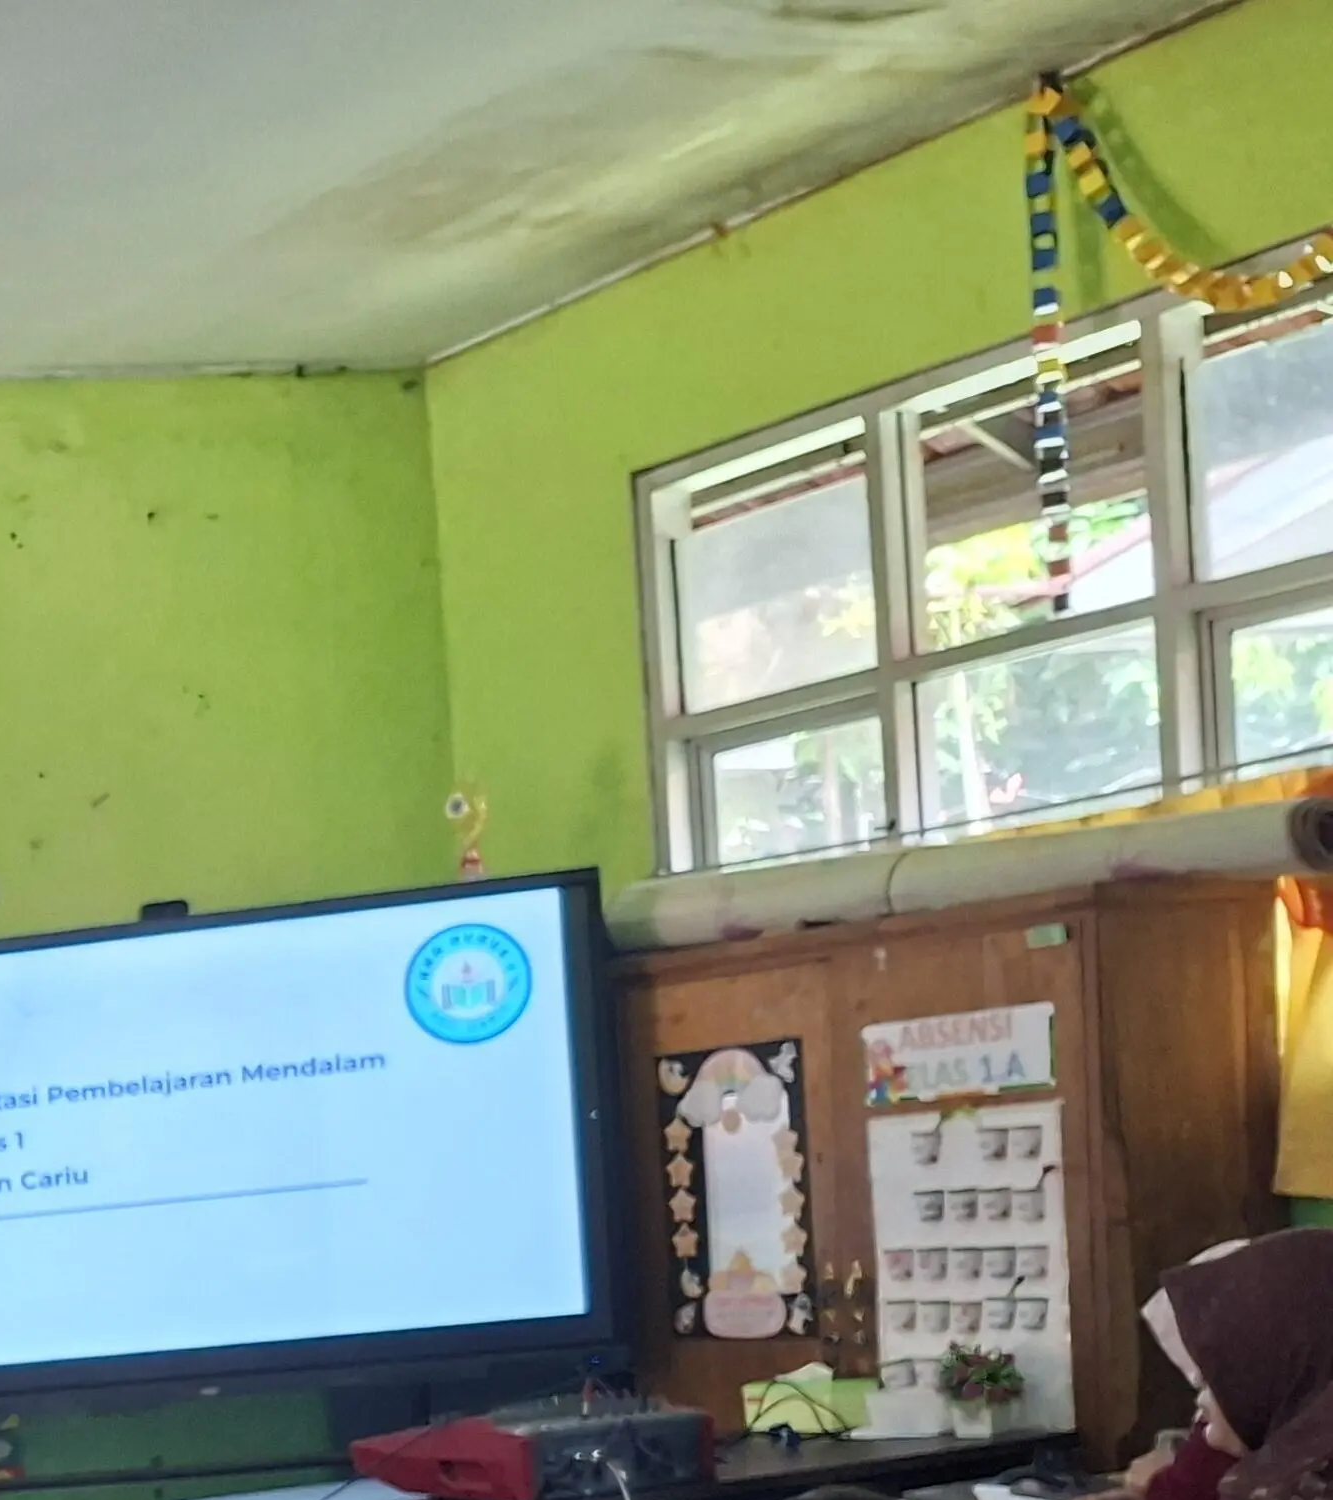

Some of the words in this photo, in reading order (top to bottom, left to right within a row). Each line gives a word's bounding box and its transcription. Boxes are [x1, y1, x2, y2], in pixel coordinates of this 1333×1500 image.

[899, 1012, 1013, 1049] ABSENSI
[47, 1066, 233, 1106] Pembelajaran
[241, 1051, 388, 1084] Mendalam
[14, 1131, 25, 1150] 1
[20, 1164, 90, 1192] Cariu
